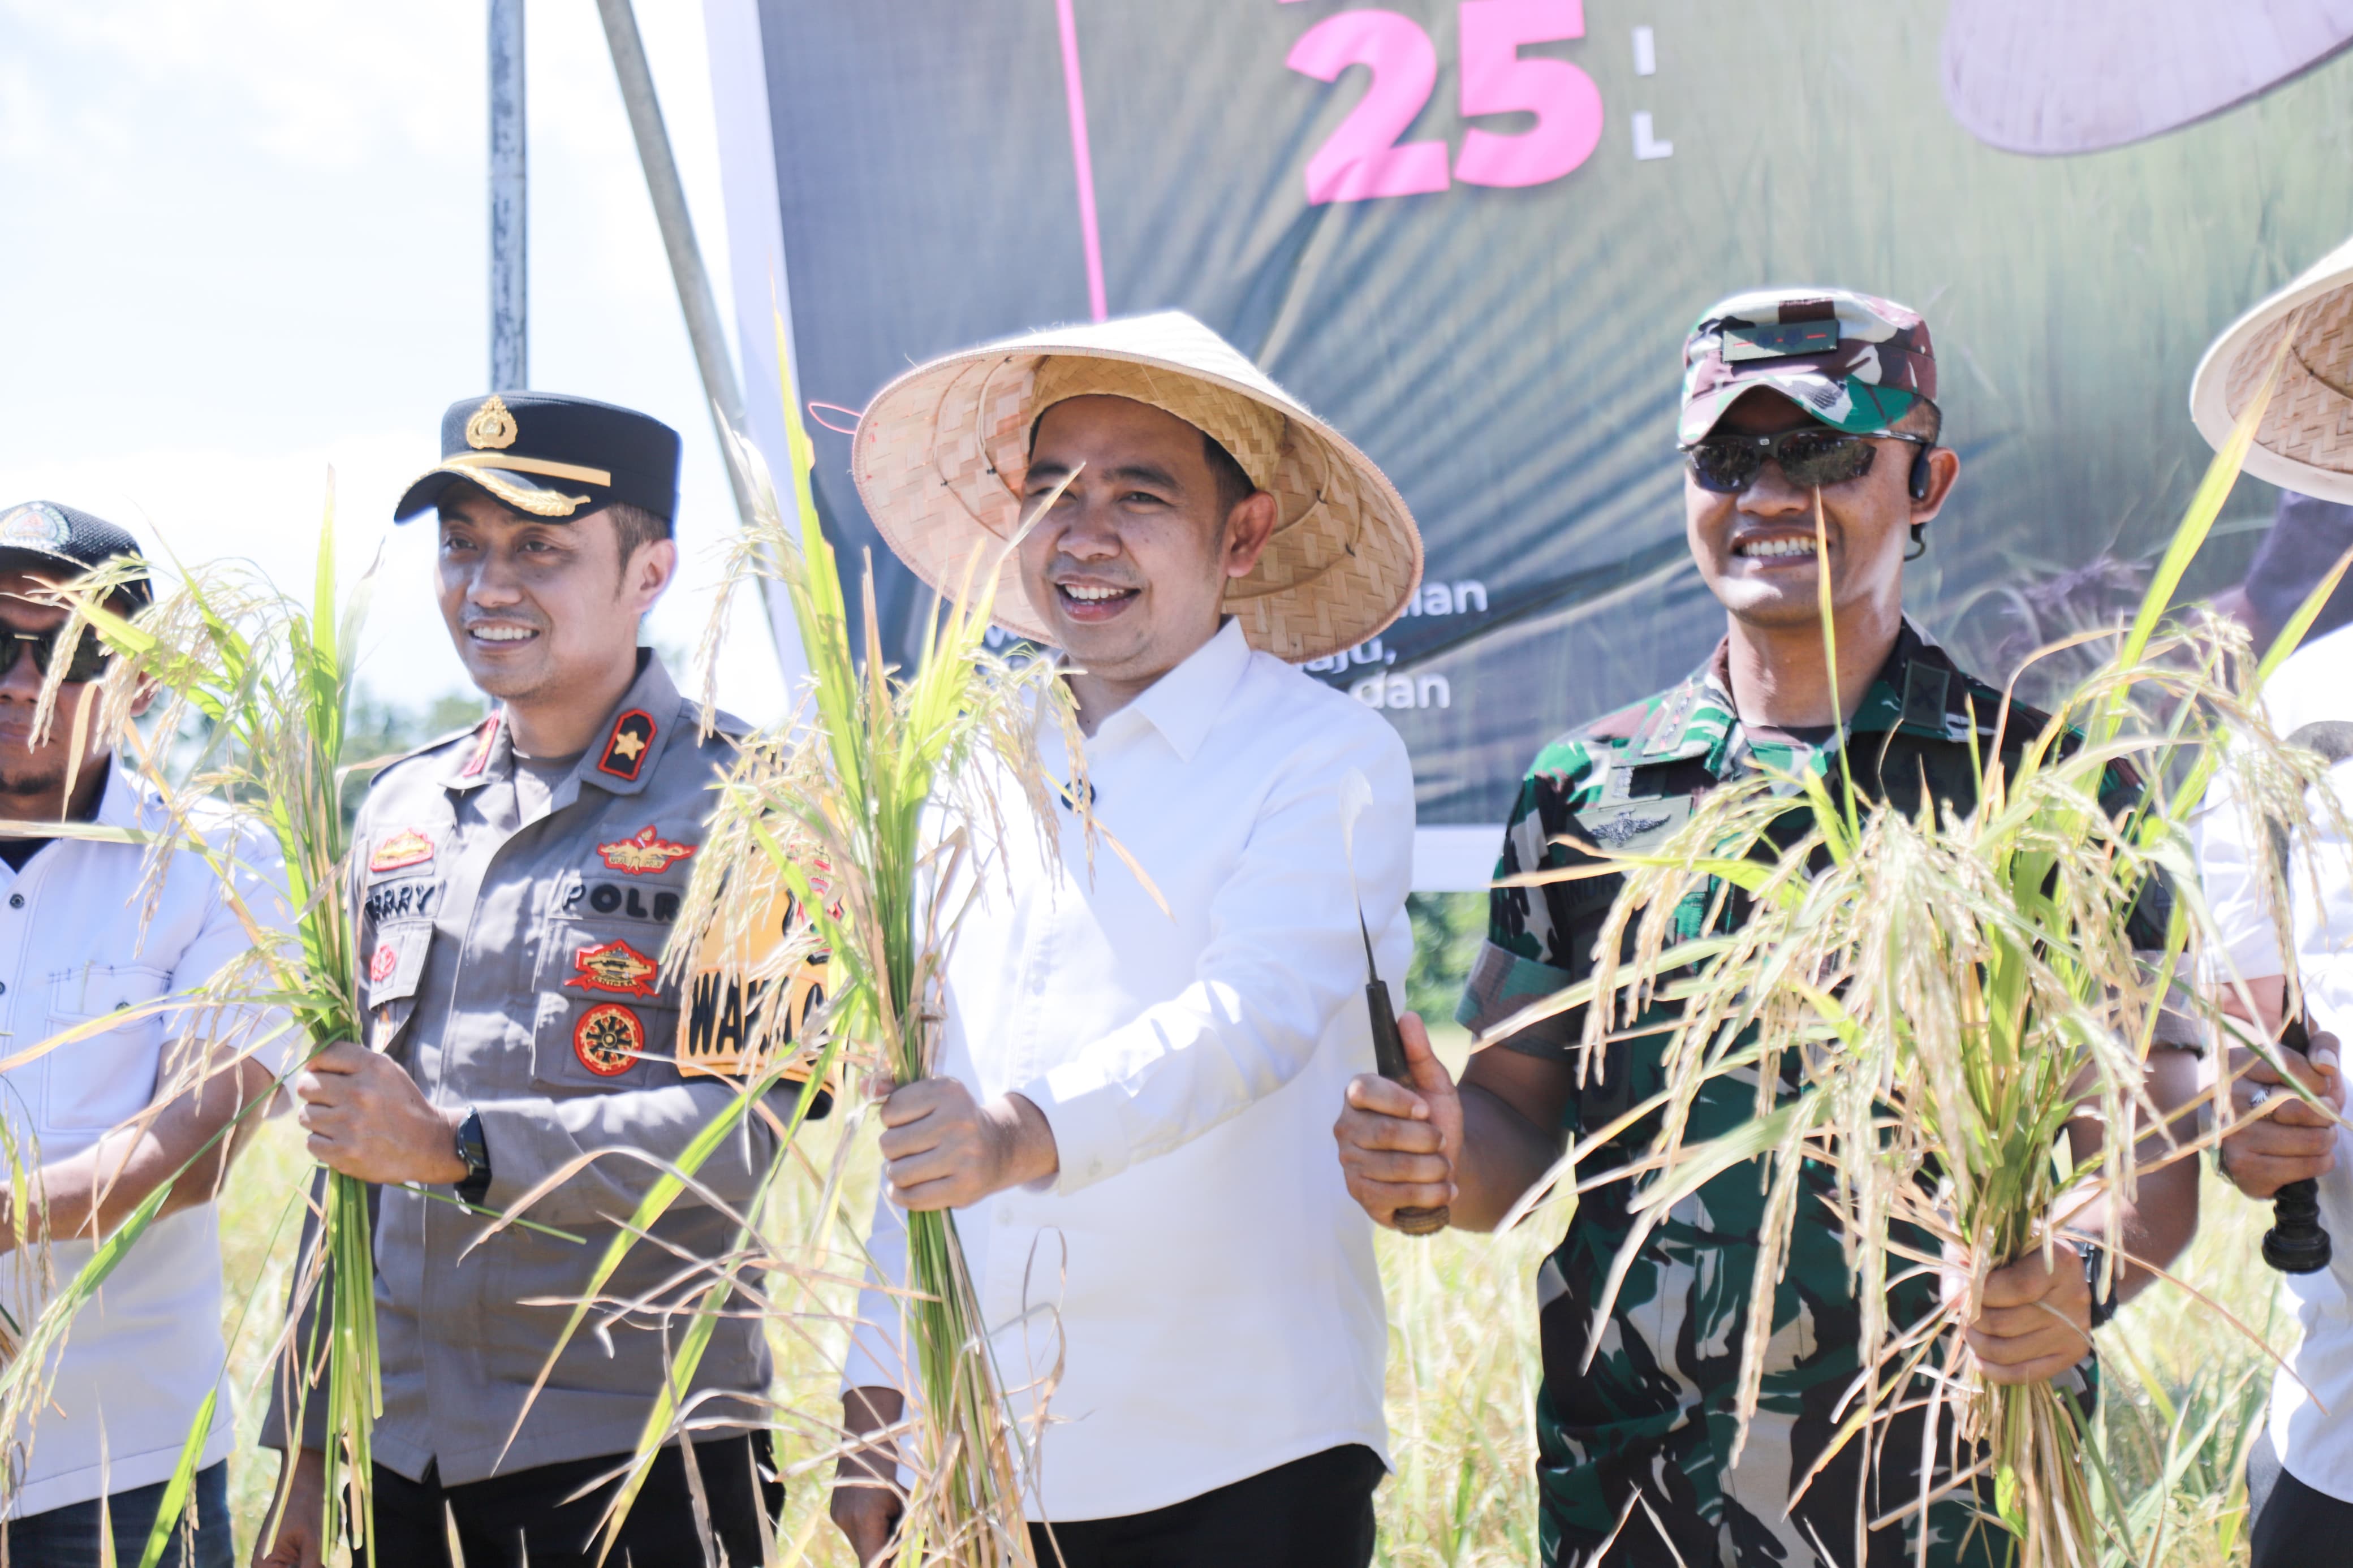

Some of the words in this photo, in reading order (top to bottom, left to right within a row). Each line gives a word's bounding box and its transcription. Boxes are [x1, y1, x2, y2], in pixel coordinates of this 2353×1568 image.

[1286, 0, 1604, 206] 25
[1348, 667, 1451, 709] dan
[562, 884, 680, 922] POLR
